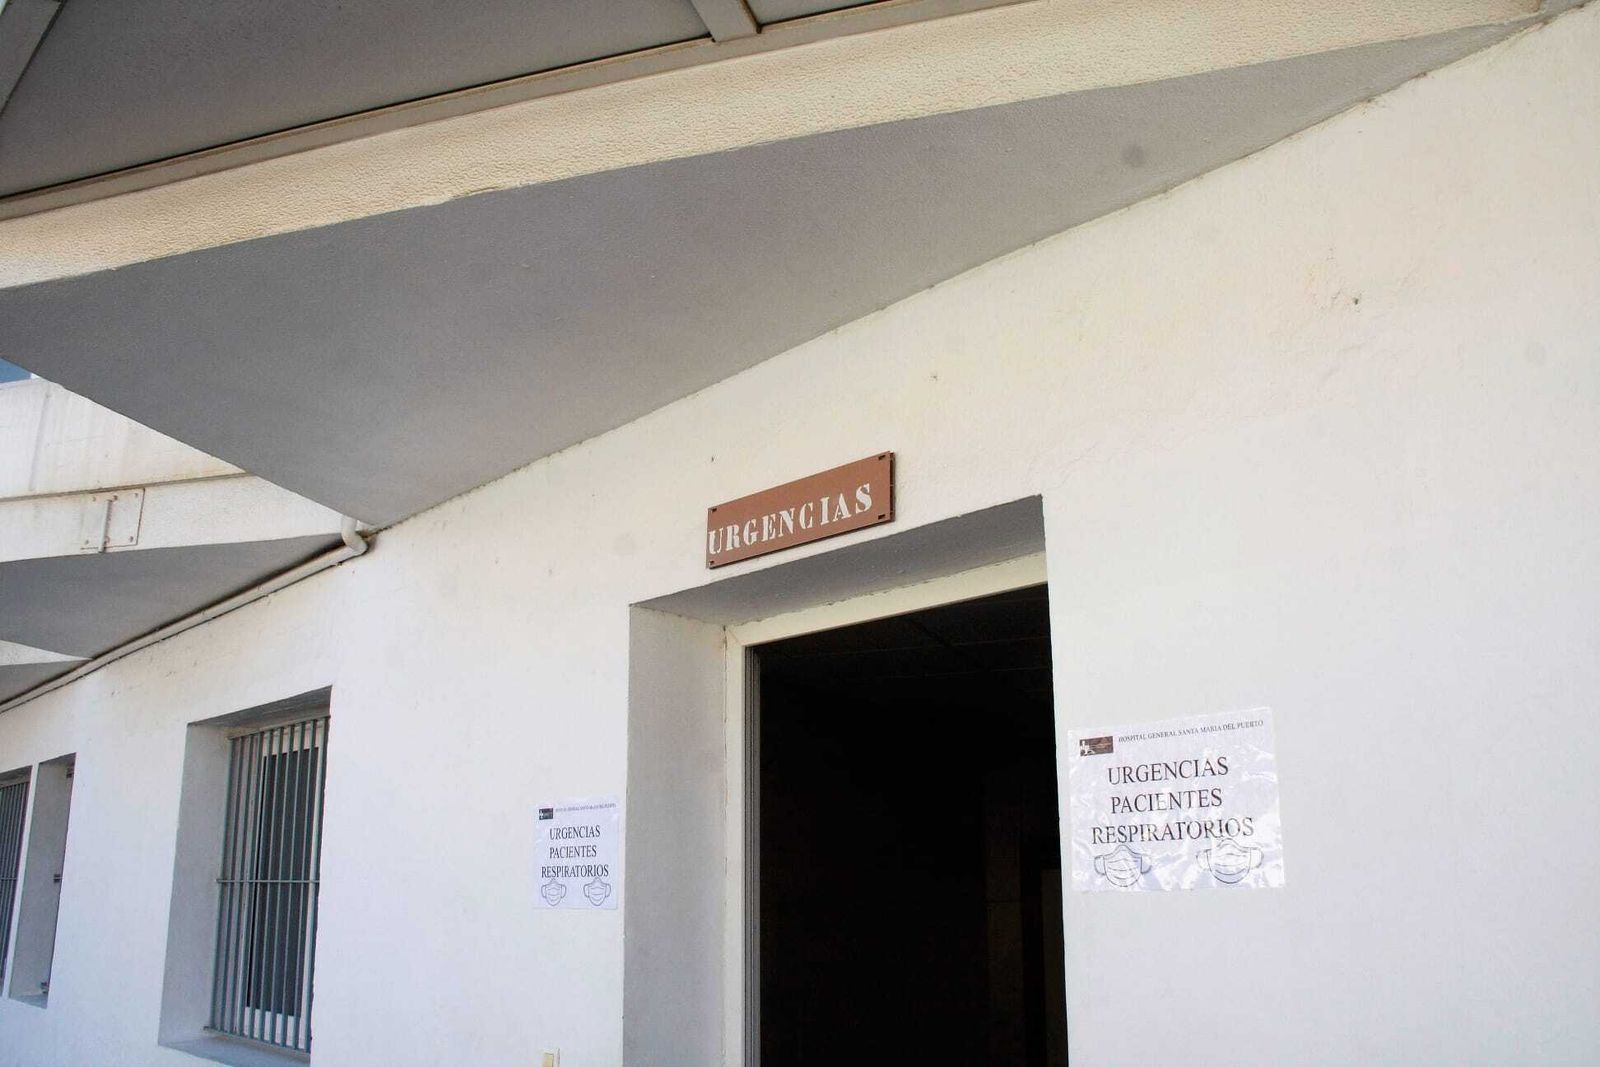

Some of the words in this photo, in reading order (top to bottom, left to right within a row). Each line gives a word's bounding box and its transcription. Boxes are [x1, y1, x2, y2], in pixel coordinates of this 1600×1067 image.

[707, 483, 873, 555] URGENCIAS
[1147, 731, 1177, 740] GENERAL
[1178, 727, 1199, 736] SANTA
[1222, 722, 1236, 731] DEL
[1108, 756, 1229, 785] URGENCIAS
[1111, 788, 1222, 814] PACIENTES
[549, 825, 601, 840] URGENCIAS
[1092, 817, 1254, 845] RESPIRATORIOS
[549, 845, 597, 859] PACIENTES
[541, 864, 609, 878] RESPIRATORIOS
